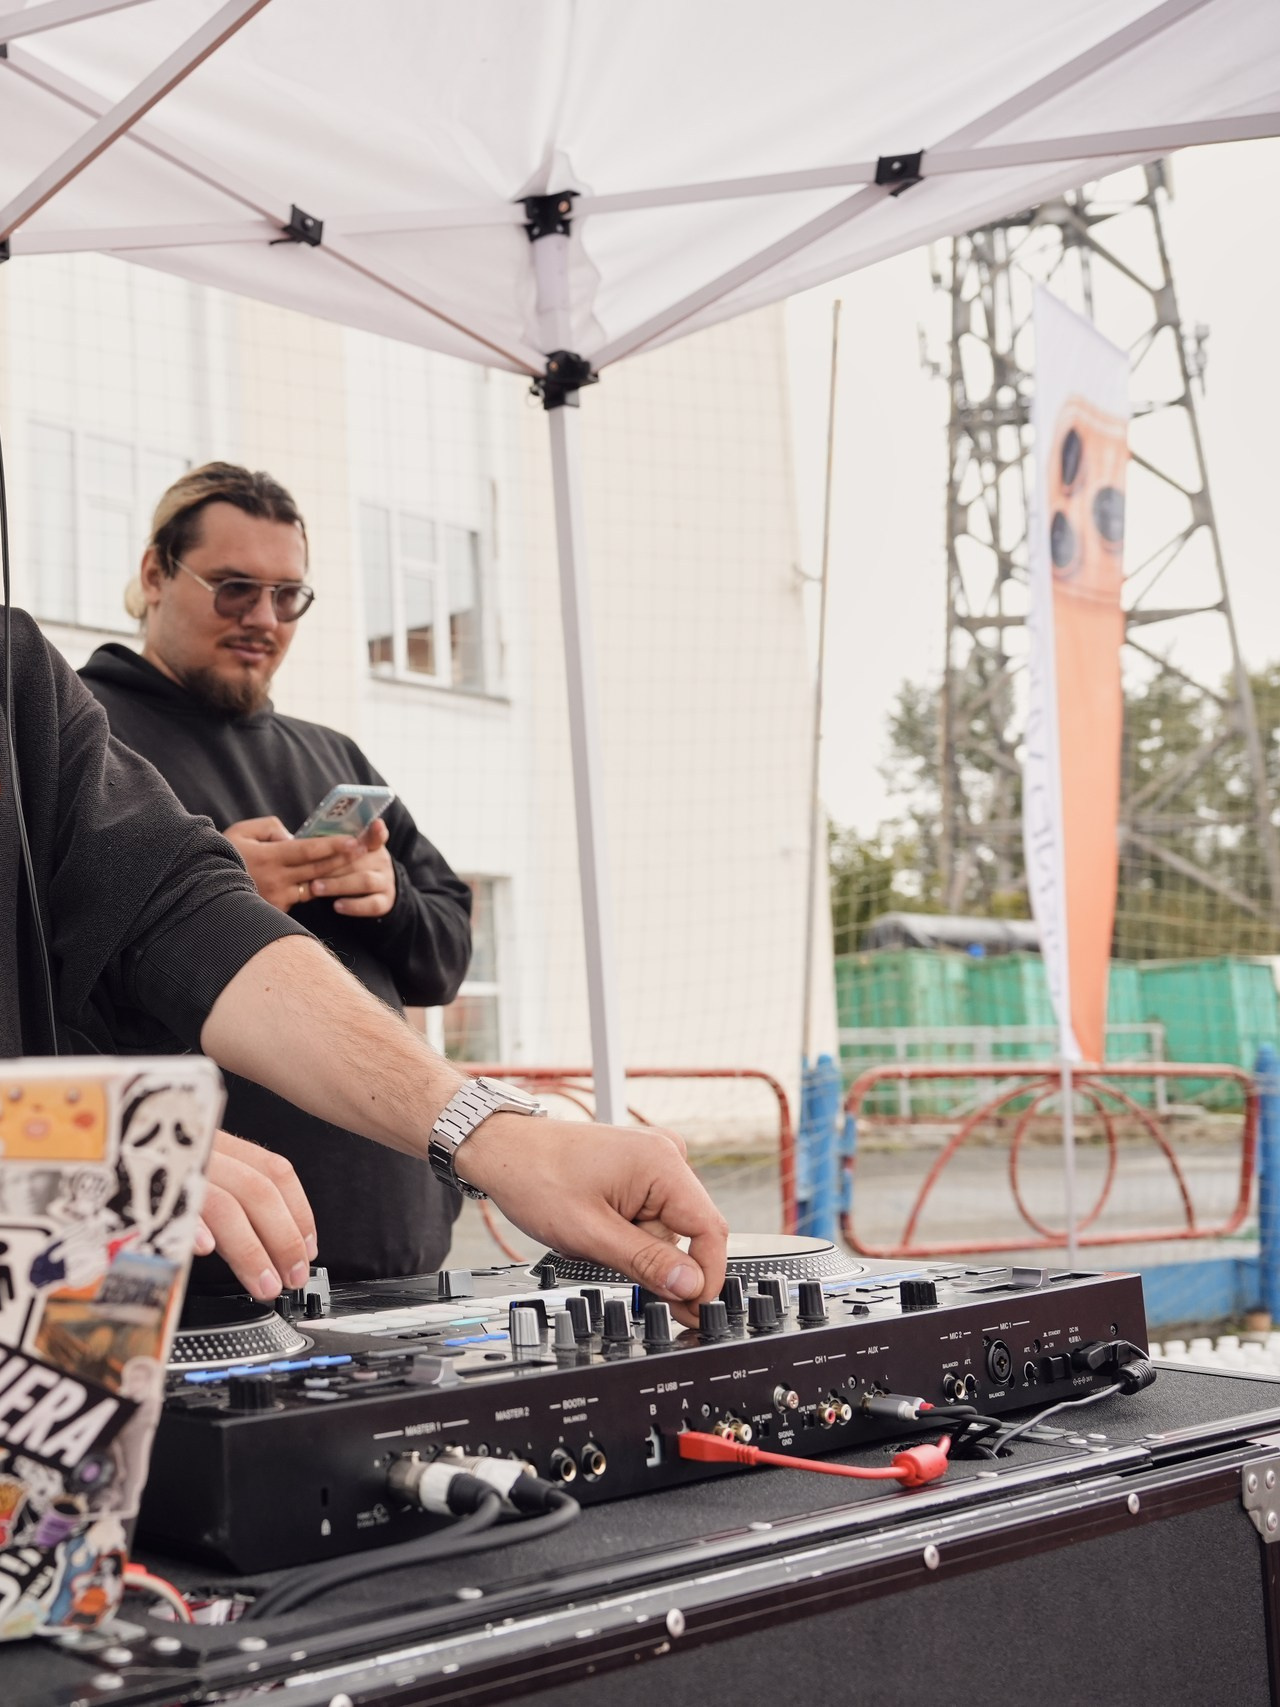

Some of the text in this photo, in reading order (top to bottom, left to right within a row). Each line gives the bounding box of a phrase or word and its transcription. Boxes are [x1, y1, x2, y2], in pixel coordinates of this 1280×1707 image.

[1000, 1322, 1010, 1330] MIC
[949, 1332, 958, 1340] MIC
[868, 1346, 878, 1354] AUX
[815, 1356, 823, 1364] CH
[732, 1371, 742, 1380] CH
[665, 1382, 678, 1392] USB
[562, 1397, 587, 1410] BOOTH
[682, 1398, 689, 1410] A
[650, 1404, 657, 1416] B
[495, 1408, 523, 1422] MASTER
[405, 1423, 436, 1437] MASTER
[778, 1430, 795, 1439] SIGNAL
[781, 1438, 792, 1446] GND
